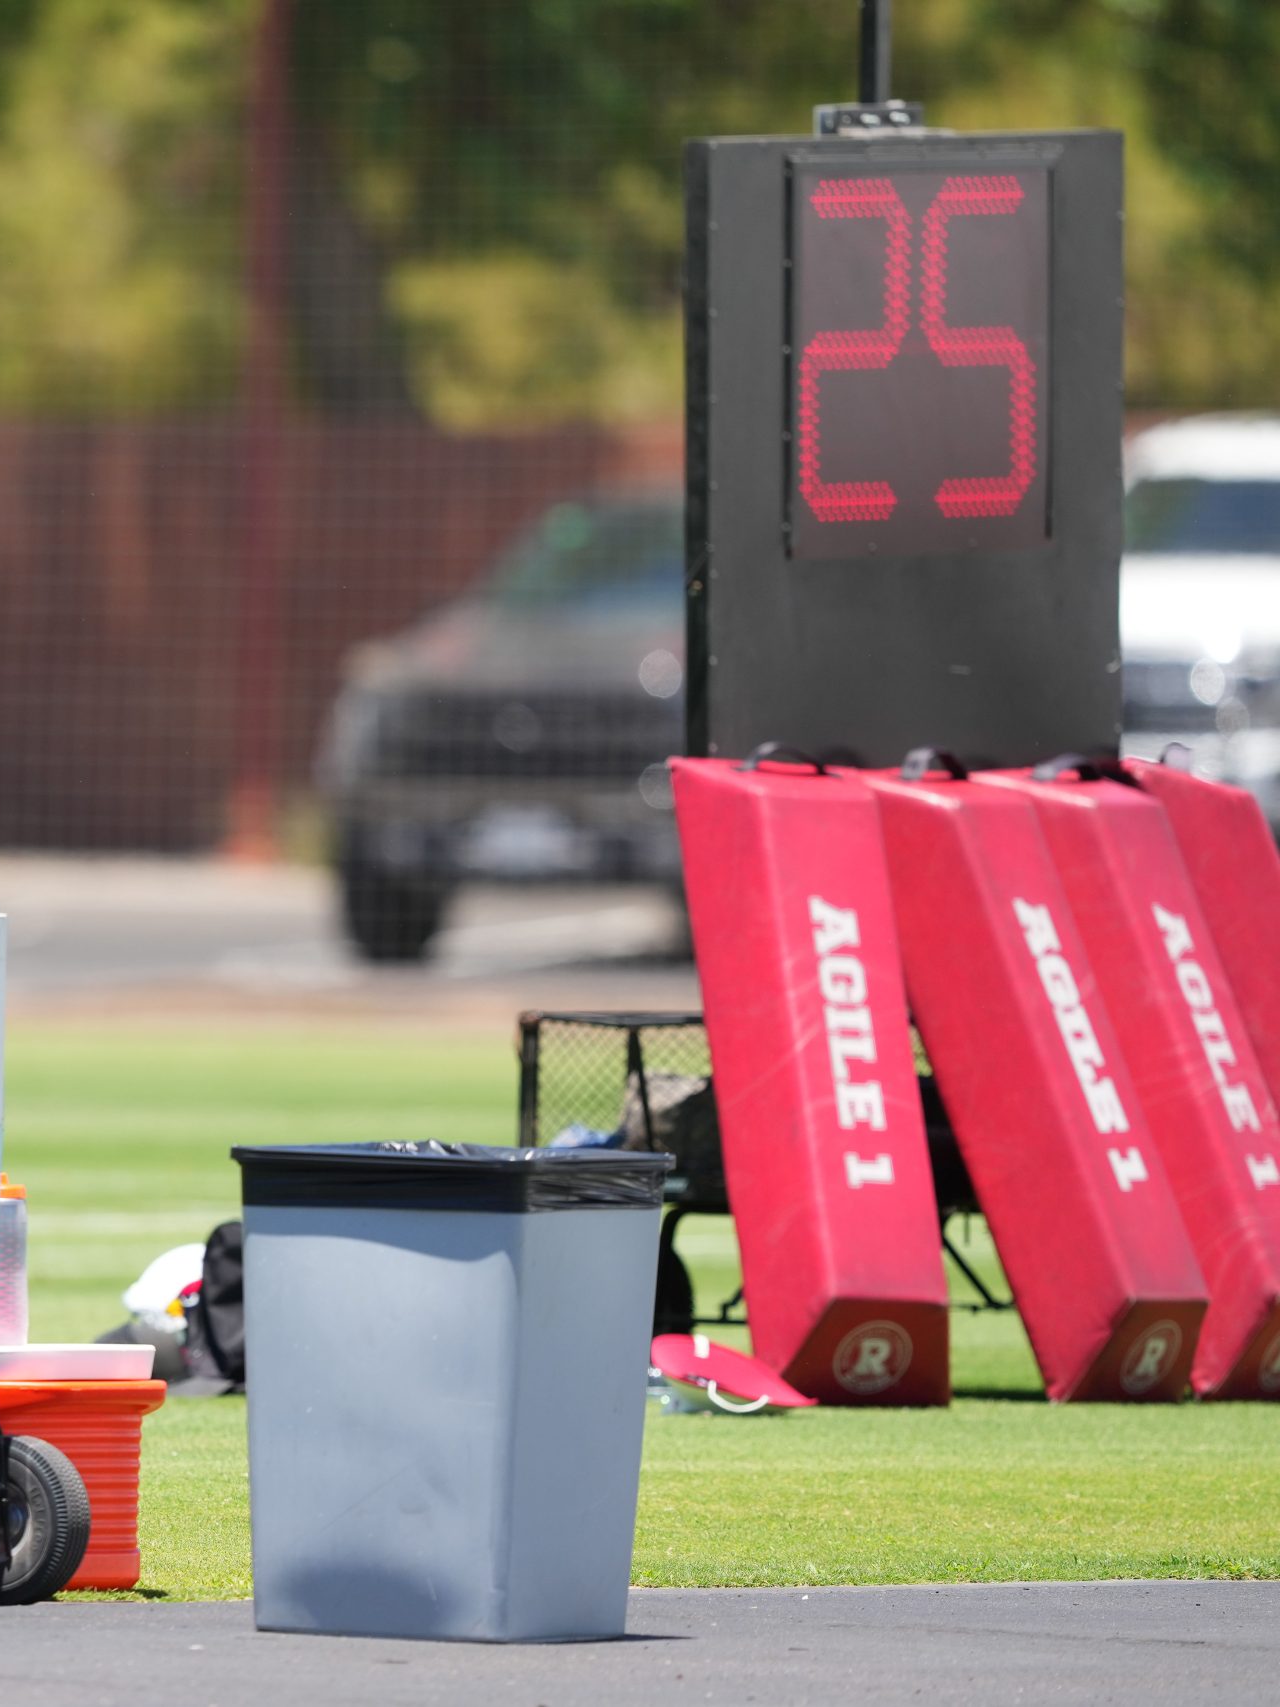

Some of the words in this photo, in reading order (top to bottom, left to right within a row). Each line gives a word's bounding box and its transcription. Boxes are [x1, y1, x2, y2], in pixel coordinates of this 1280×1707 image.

[798, 176, 1037, 522] 25
[807, 895, 888, 1131] AGILE
[1011, 897, 1130, 1134] AGILE
[1107, 1148, 1149, 1192] 1
[1151, 901, 1262, 1133] AGILE
[1245, 1153, 1280, 1190] 1
[843, 1152, 896, 1189] 1
[853, 1337, 891, 1377] R
[1134, 1337, 1167, 1377] R
